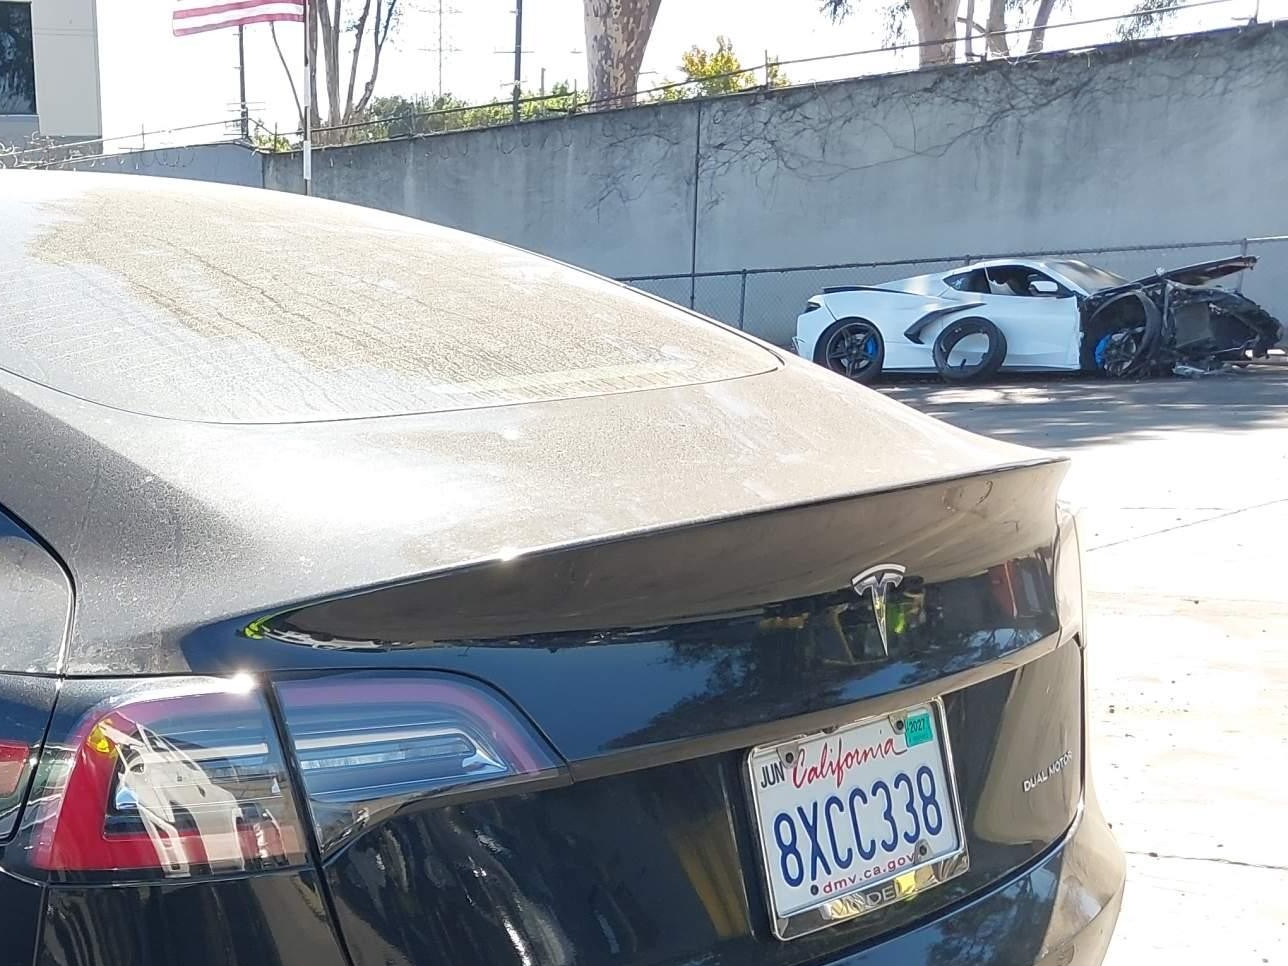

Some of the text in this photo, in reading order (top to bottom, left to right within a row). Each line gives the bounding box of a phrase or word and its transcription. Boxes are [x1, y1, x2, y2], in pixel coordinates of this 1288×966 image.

[909, 718, 926, 734] 2027
[760, 760, 786, 789] JUN
[792, 737, 908, 788] California
[1023, 750, 1072, 792] DUAL MOTOR
[773, 765, 943, 888] 8XCC338
[822, 854, 916, 894] dmv.ca.gov
